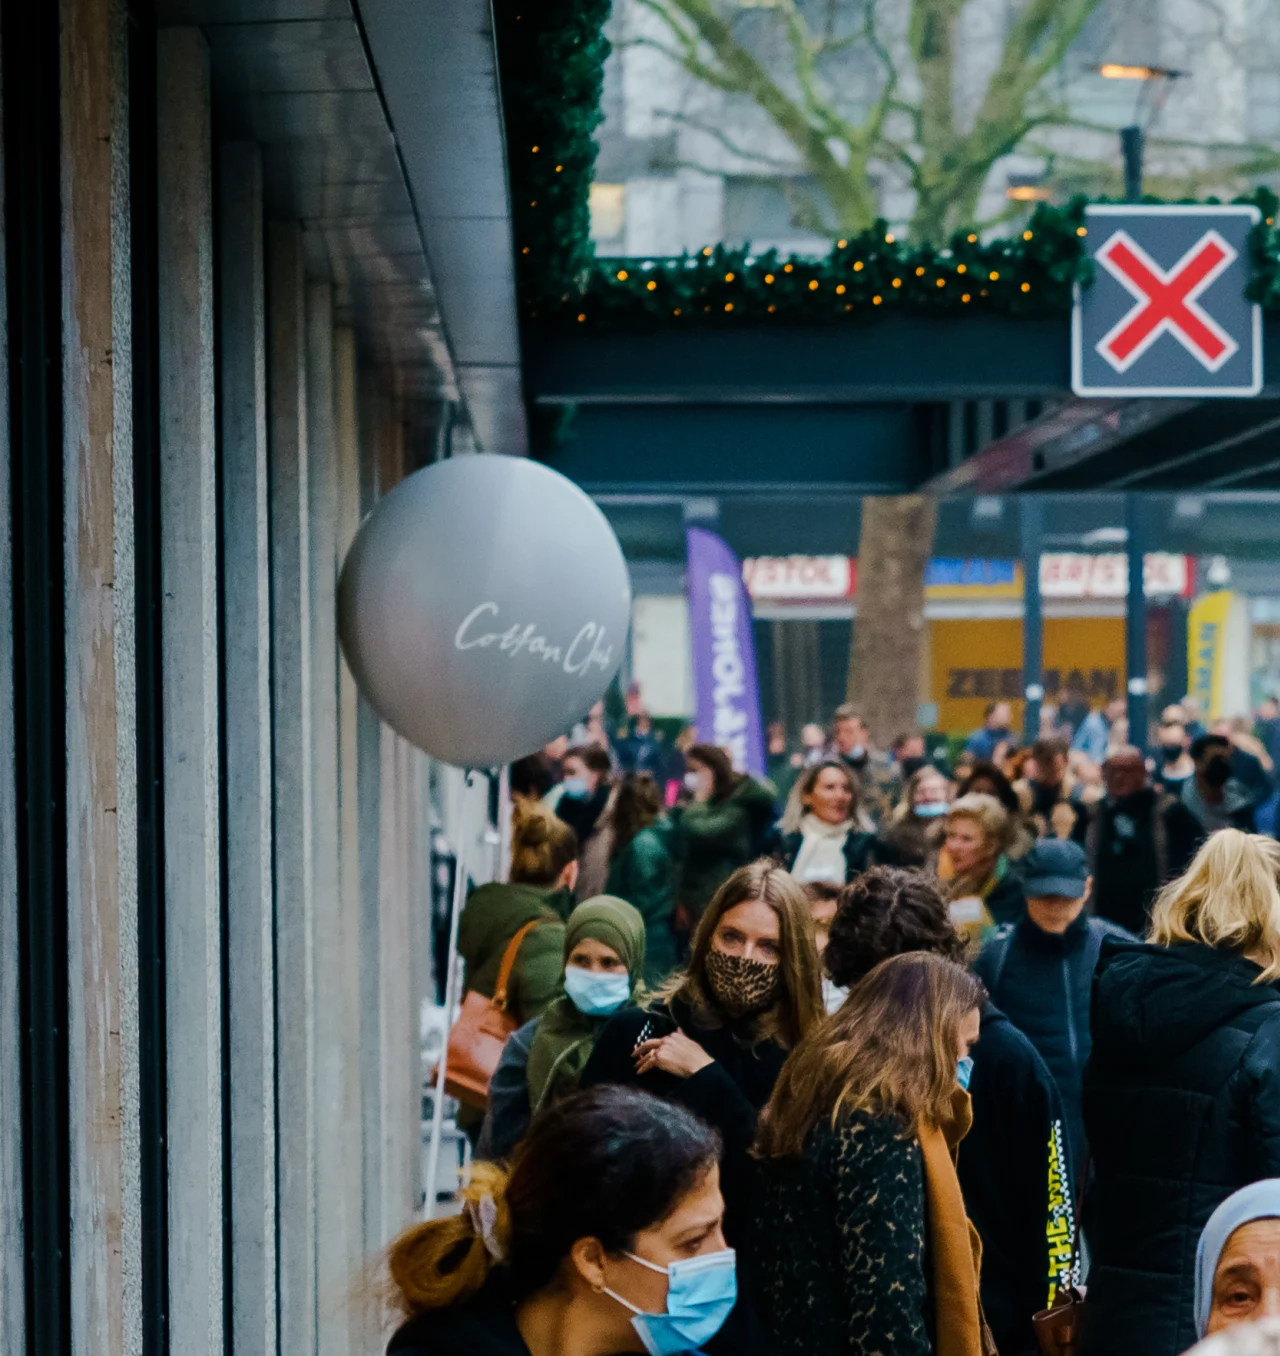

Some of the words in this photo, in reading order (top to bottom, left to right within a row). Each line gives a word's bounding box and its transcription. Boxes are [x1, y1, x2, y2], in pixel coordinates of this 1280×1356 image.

[1042, 555, 1169, 584] BRISOL
[455, 601, 561, 662] Cotton
[1046, 1215, 1073, 1278] THE
